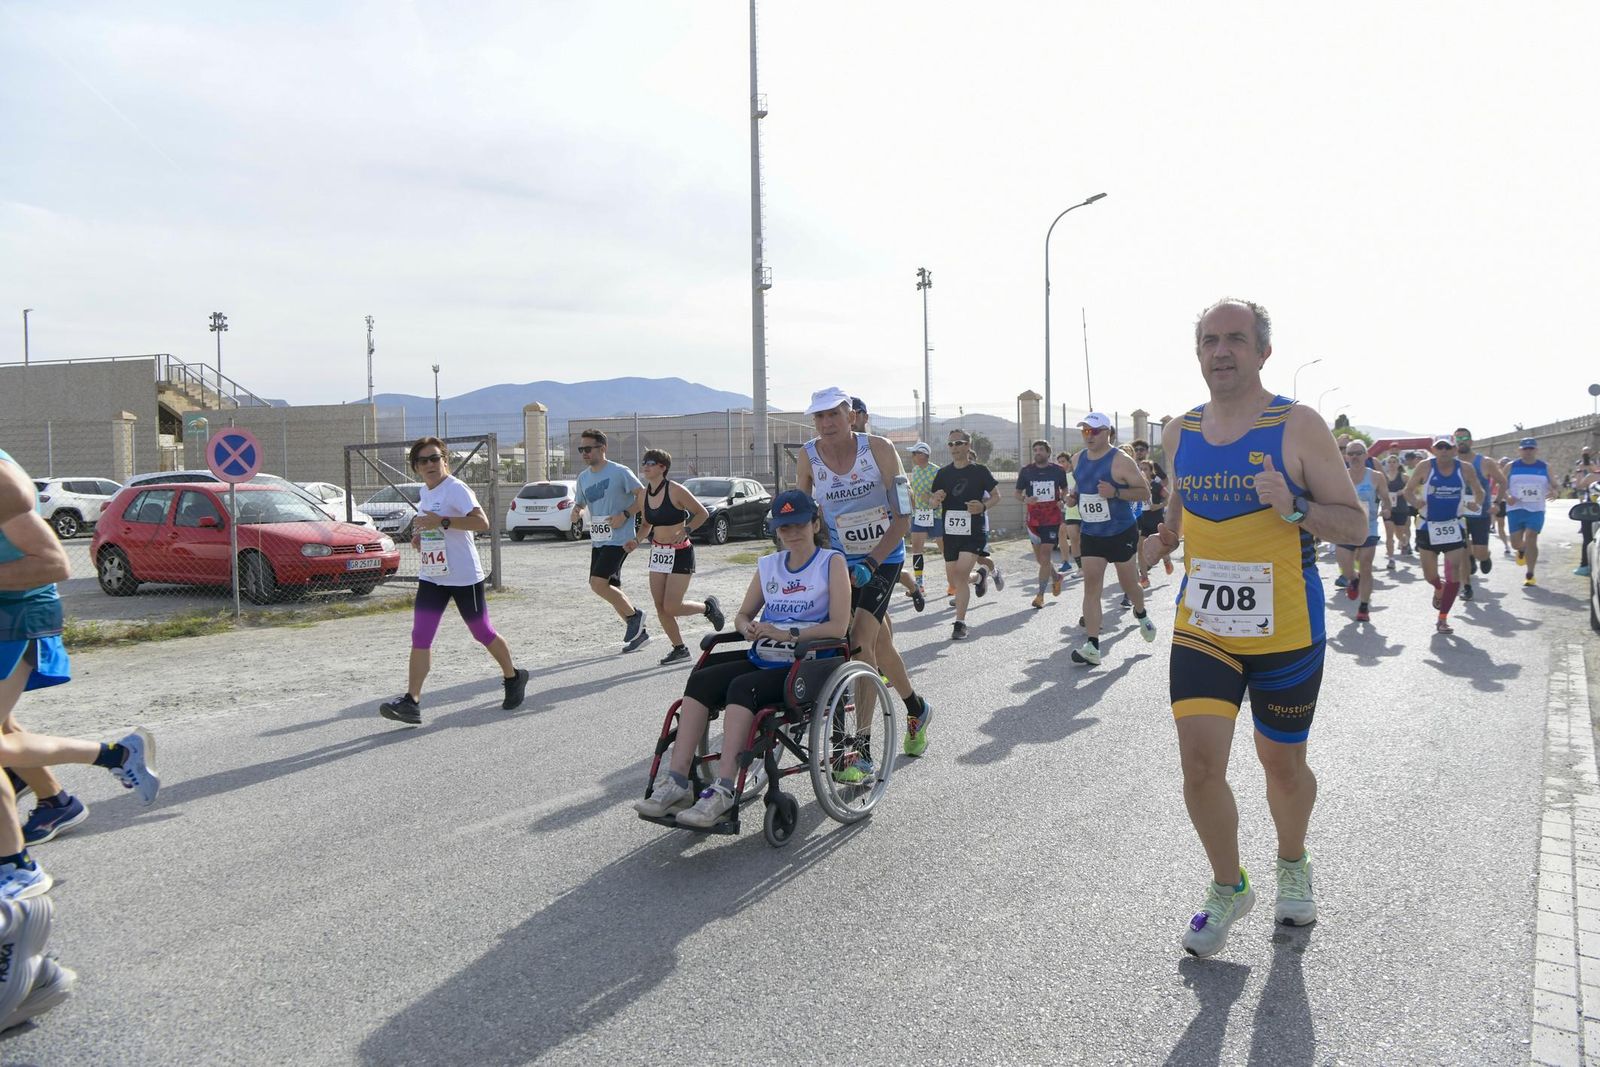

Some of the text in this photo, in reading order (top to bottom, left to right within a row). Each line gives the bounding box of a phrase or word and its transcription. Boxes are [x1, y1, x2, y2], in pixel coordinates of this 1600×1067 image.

[1177, 470, 1258, 495] agustino
[826, 481, 875, 500] MARACENA
[1036, 488, 1050, 496] 541
[1083, 503, 1103, 513] 188
[590, 523, 611, 534] 3066
[949, 518, 967, 527] 573
[845, 523, 885, 541] GUÍA
[1434, 526, 1456, 536] 359
[652, 553, 674, 565] 3022
[1199, 583, 1256, 611] 708
[766, 600, 815, 614] MARACNA
